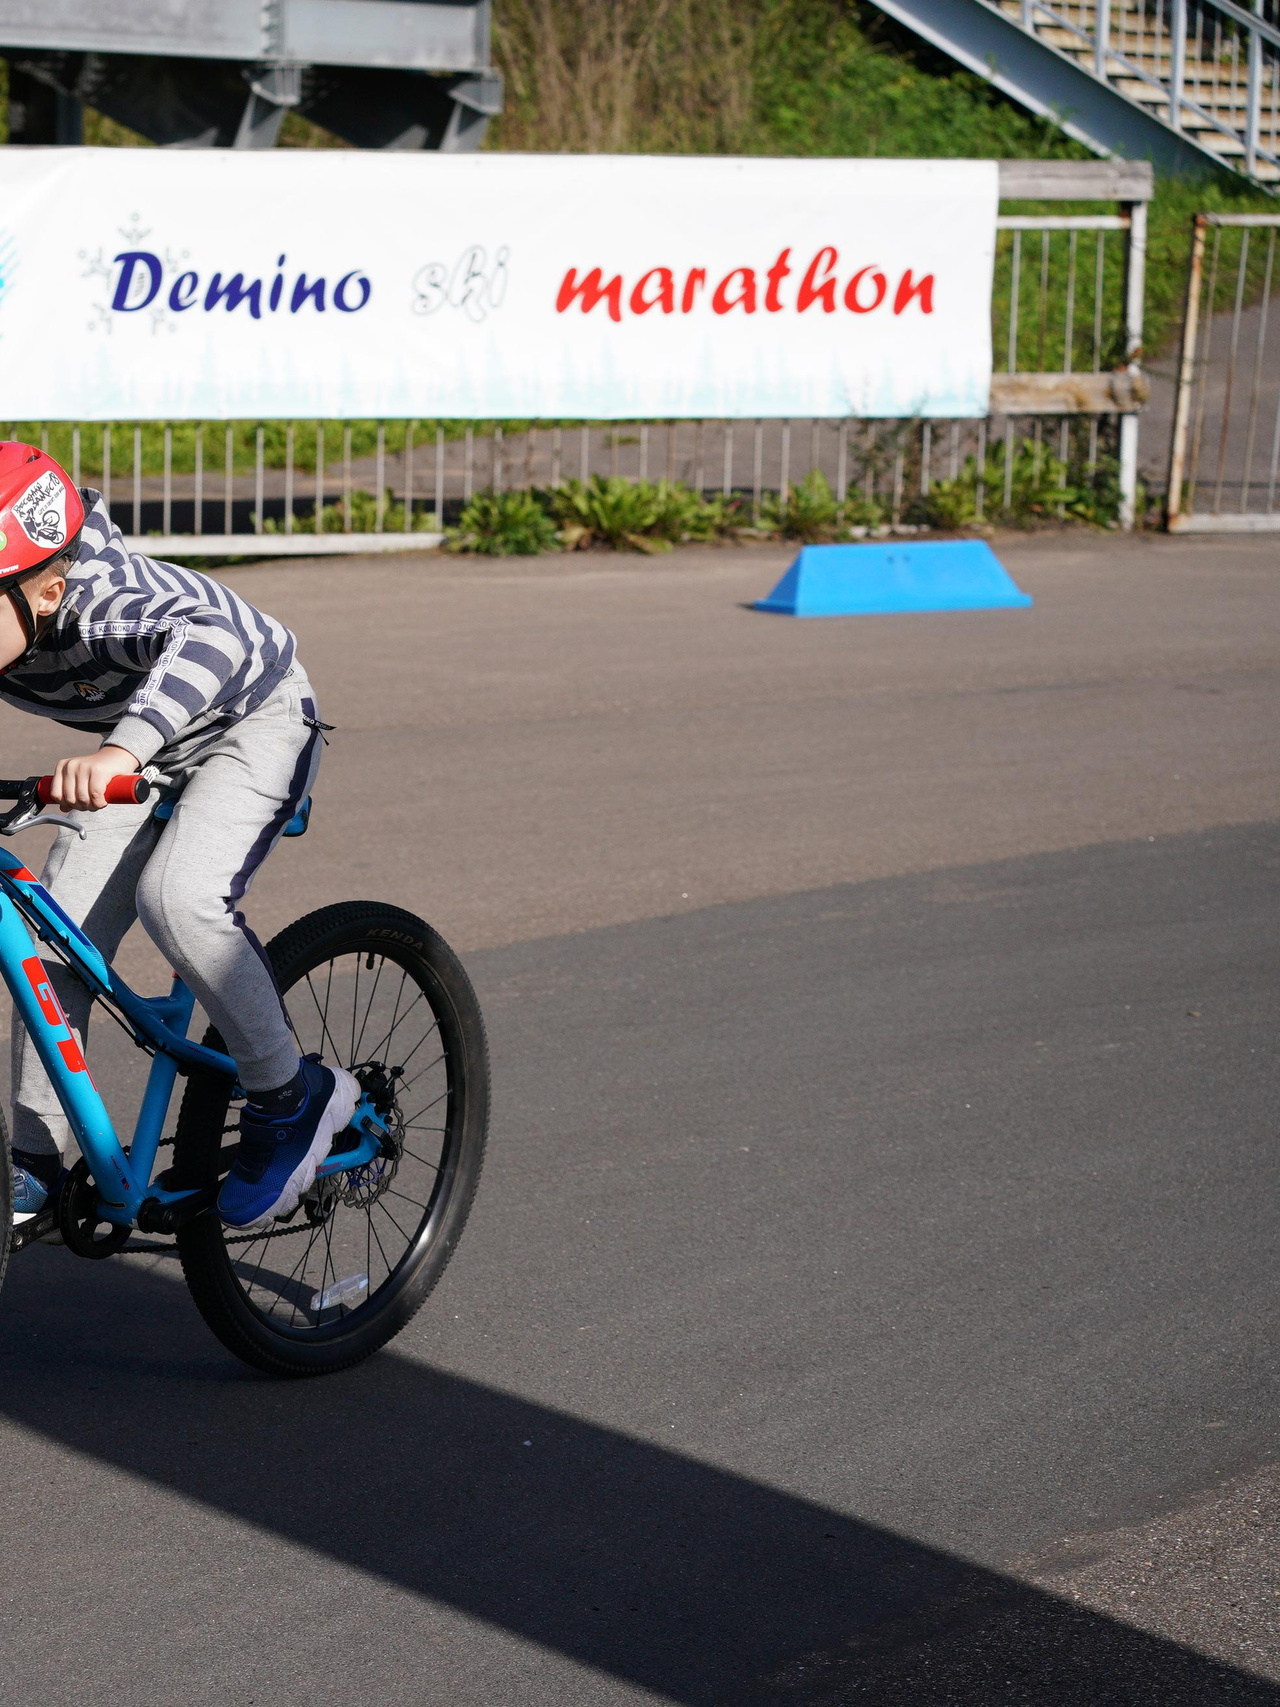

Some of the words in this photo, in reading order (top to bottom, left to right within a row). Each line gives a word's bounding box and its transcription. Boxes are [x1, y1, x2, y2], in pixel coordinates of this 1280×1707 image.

[111, 251, 371, 320] Demino
[411, 244, 509, 323] ski
[555, 246, 935, 323] marathon
[366, 929, 423, 950] KENDA
